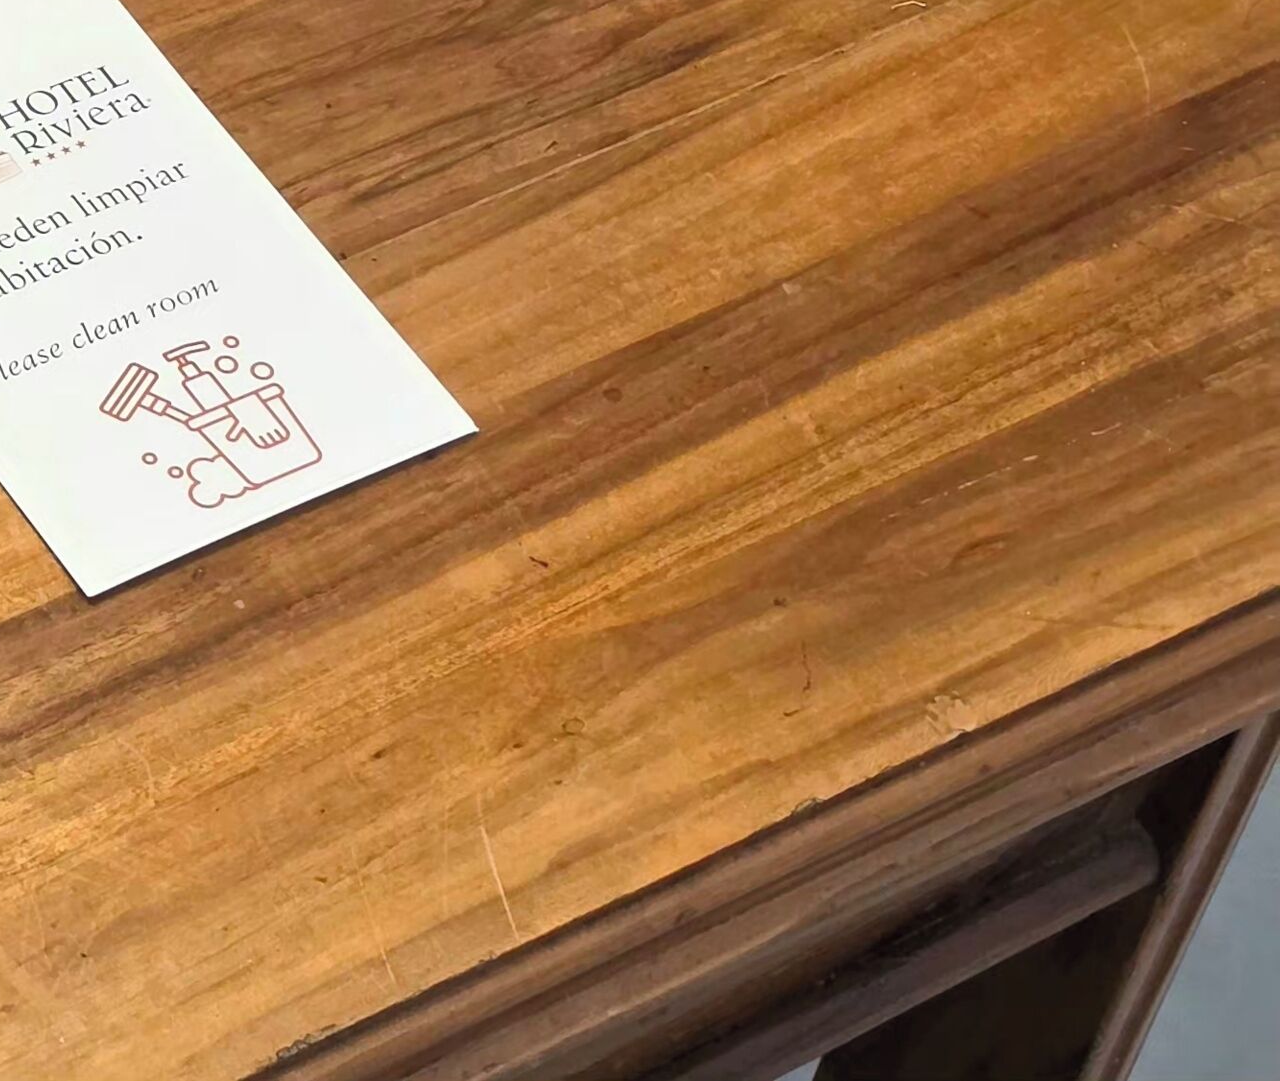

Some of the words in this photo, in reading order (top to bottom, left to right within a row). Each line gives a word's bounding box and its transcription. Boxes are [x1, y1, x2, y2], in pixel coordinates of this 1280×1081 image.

[11, 92, 150, 154] Riviera
[71, 162, 190, 217] limpiar
[72, 311, 141, 349] clean
[146, 278, 220, 318] room
